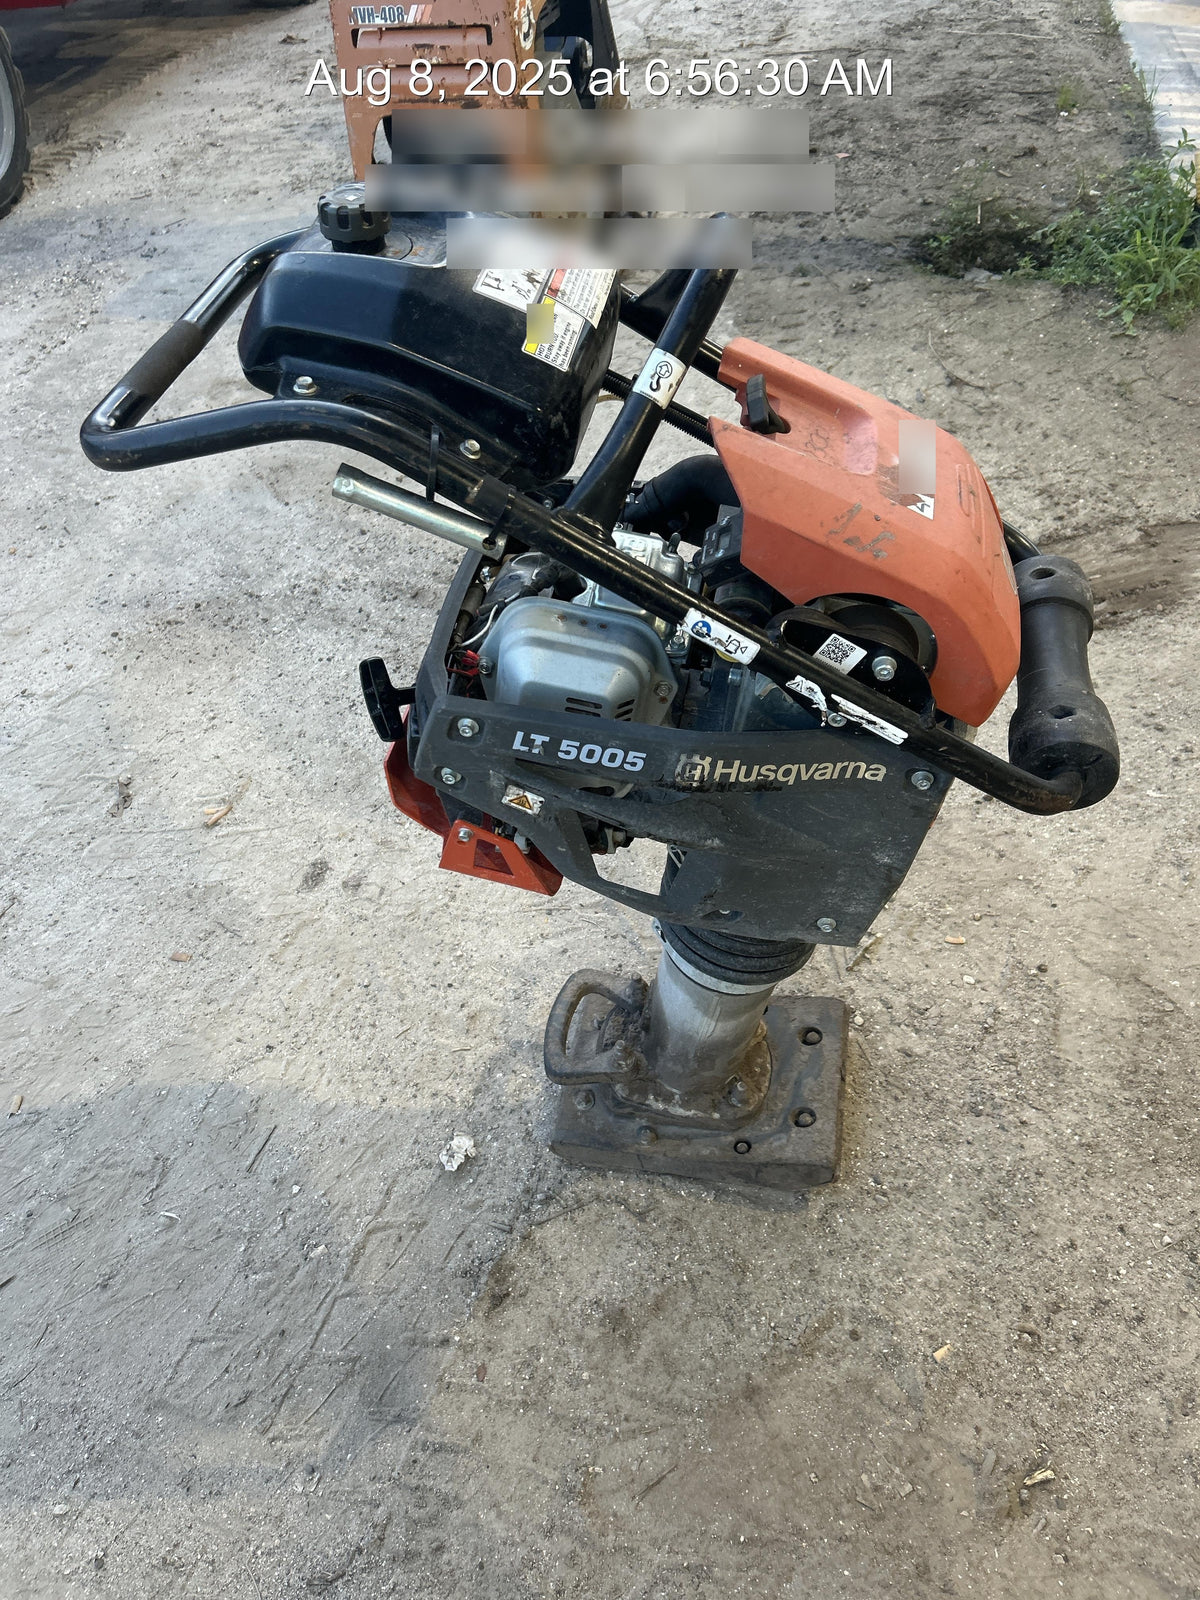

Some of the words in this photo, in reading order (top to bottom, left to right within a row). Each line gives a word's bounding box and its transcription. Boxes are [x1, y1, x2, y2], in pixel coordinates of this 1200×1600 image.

[512, 731, 550, 754] LT
[557, 739, 647, 772] 5005
[713, 759, 887, 786] Husqvarna
